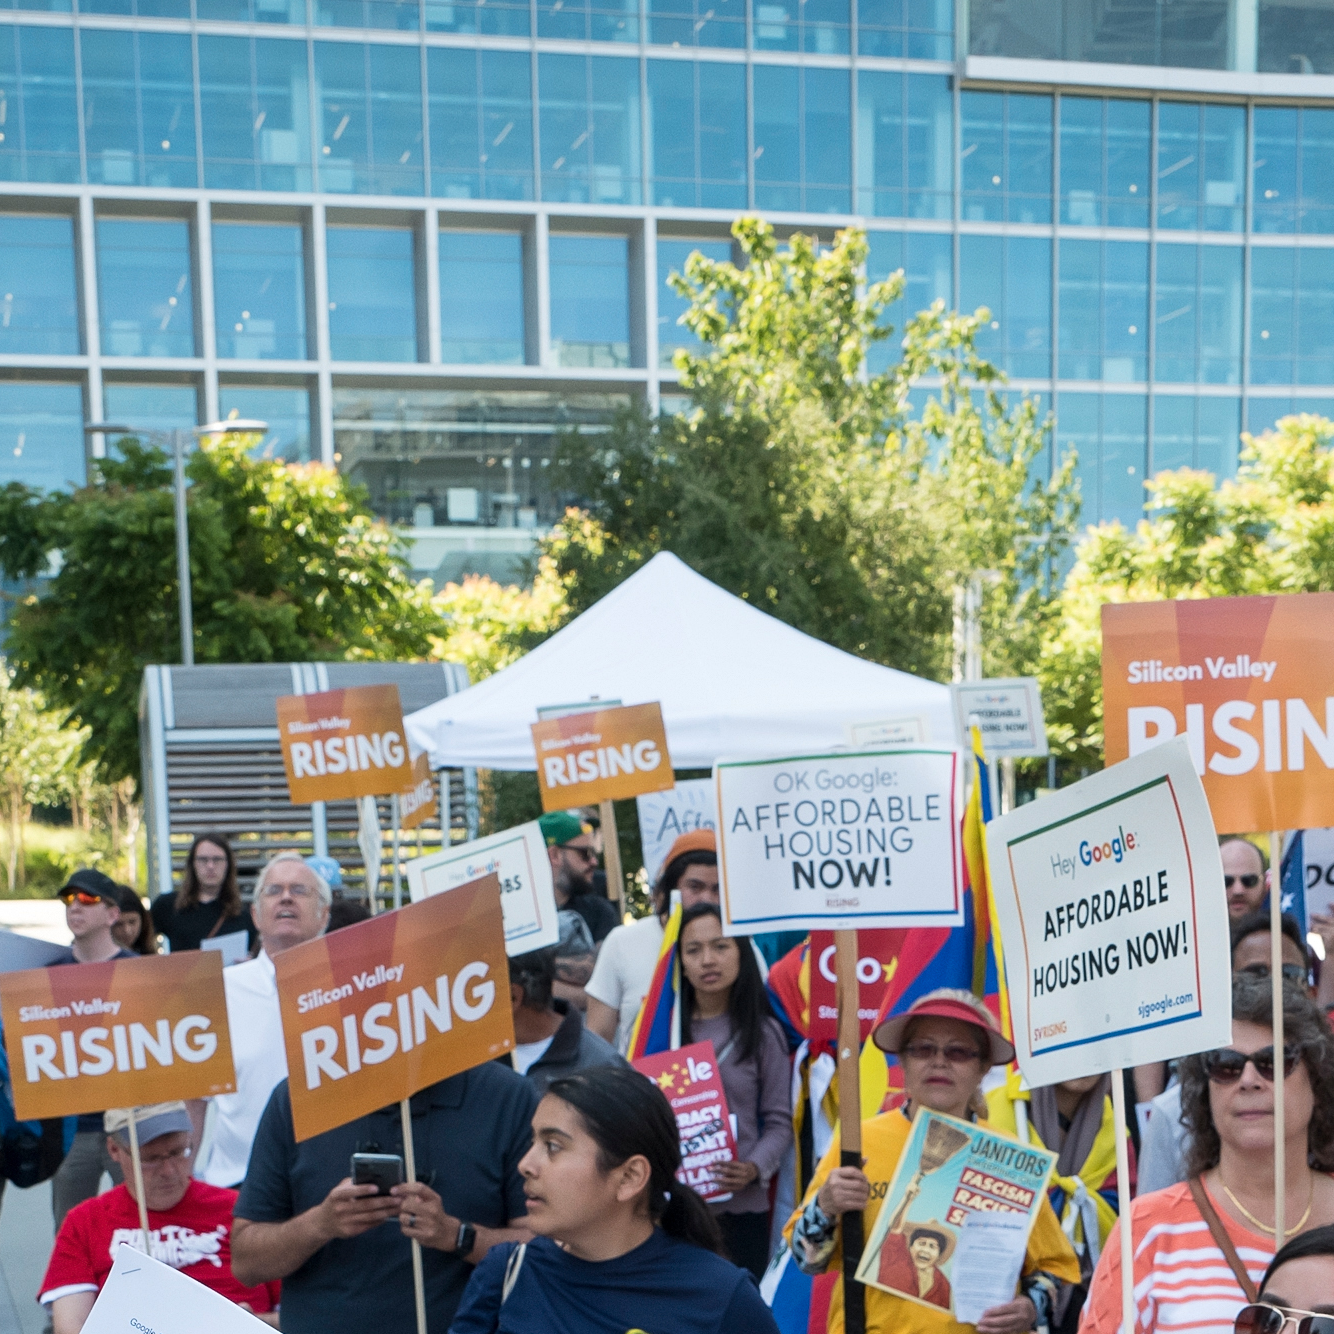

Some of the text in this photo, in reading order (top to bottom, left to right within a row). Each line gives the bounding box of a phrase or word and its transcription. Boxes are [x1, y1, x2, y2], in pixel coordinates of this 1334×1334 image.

[1127, 655, 1277, 684] Silicon Valley
[288, 717, 351, 734] Silicon Valley
[290, 731, 405, 778] RISING
[544, 739, 661, 789] RISING
[774, 767, 898, 793] OK Google:
[732, 794, 940, 832] AFFORDABLE
[765, 826, 913, 859] HOUSING
[1050, 826, 1140, 880] Hey Google:
[792, 857, 891, 890] NOW!
[1044, 870, 1168, 942] AFFORDABLE
[1034, 921, 1187, 997] HOUSING NOW!
[297, 964, 404, 1014] Silicon Valley
[1138, 992, 1193, 1018] sjgoogle.com
[19, 998, 121, 1022] Silicon Valley
[301, 961, 495, 1091] RISING
[22, 1015, 217, 1083] RISING
[971, 1137, 1047, 1177] JANITORS
[962, 1171, 1032, 1205] FASCISM
